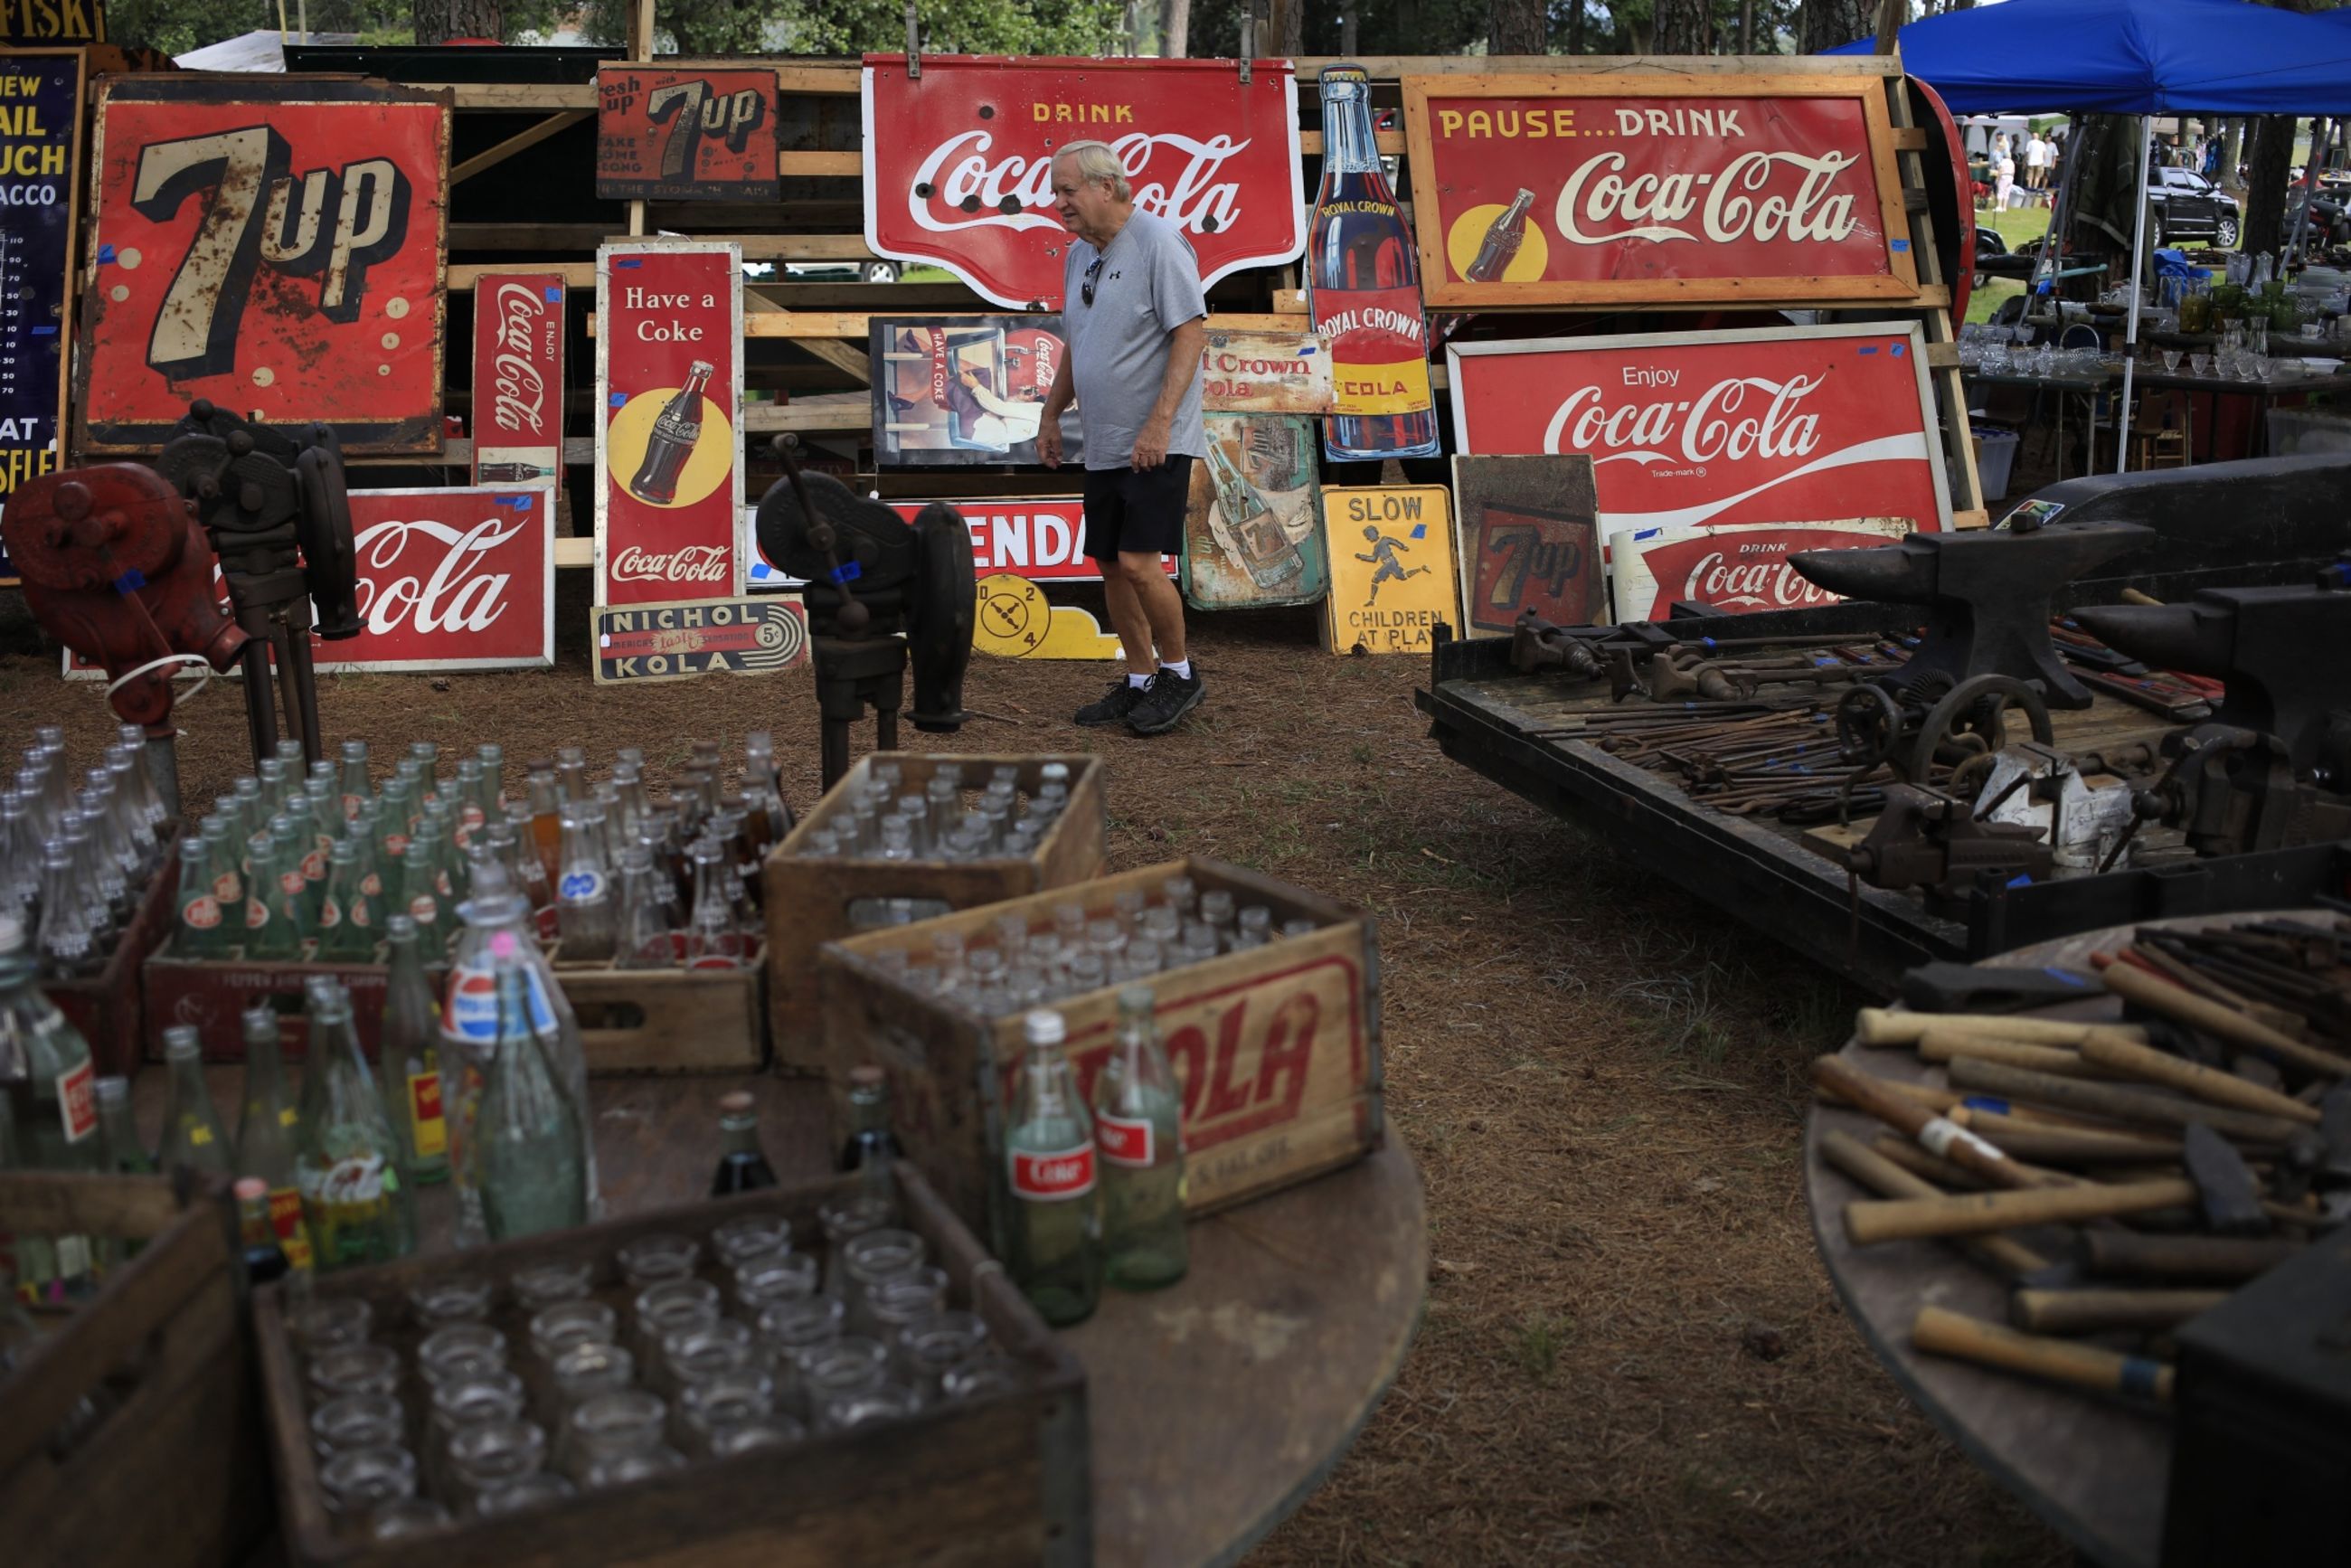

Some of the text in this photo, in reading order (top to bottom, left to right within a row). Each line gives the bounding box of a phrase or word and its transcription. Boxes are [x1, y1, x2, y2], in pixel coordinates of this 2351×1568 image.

[607, 96, 635, 116] up
[1033, 102, 1135, 123] DRINK
[1554, 149, 1861, 244] Coca-Cola
[1321, 201, 1395, 218] ROYAL CROWN
[8, 256, 22, 264] 90
[625, 287, 716, 309] Have a
[637, 320, 703, 342] Coke
[1363, 307, 1421, 341] CROWN
[545, 321, 555, 362] ENJOY
[496, 283, 544, 437] Coca-Cola
[933, 333, 946, 401] HAVE A COKE
[1217, 352, 1312, 375] Crown
[1203, 378, 1253, 397] ola
[1622, 365, 1680, 389] Enjoy
[1345, 381, 1409, 396] COLA
[1544, 372, 1827, 466] Coca-Cola
[1651, 468, 1695, 478] Trade-mark
[1348, 496, 1423, 522] SLOW
[1739, 543, 1788, 553] DRINK
[611, 544, 731, 582] Coca-Cola
[1025, 587, 1035, 601] 2
[612, 605, 760, 632] NICHOL
[1349, 611, 1443, 628] CHILDREN
[1023, 631, 1036, 647] 4
[1357, 628, 1434, 646] AT PLA
[615, 651, 732, 677] KOLA
